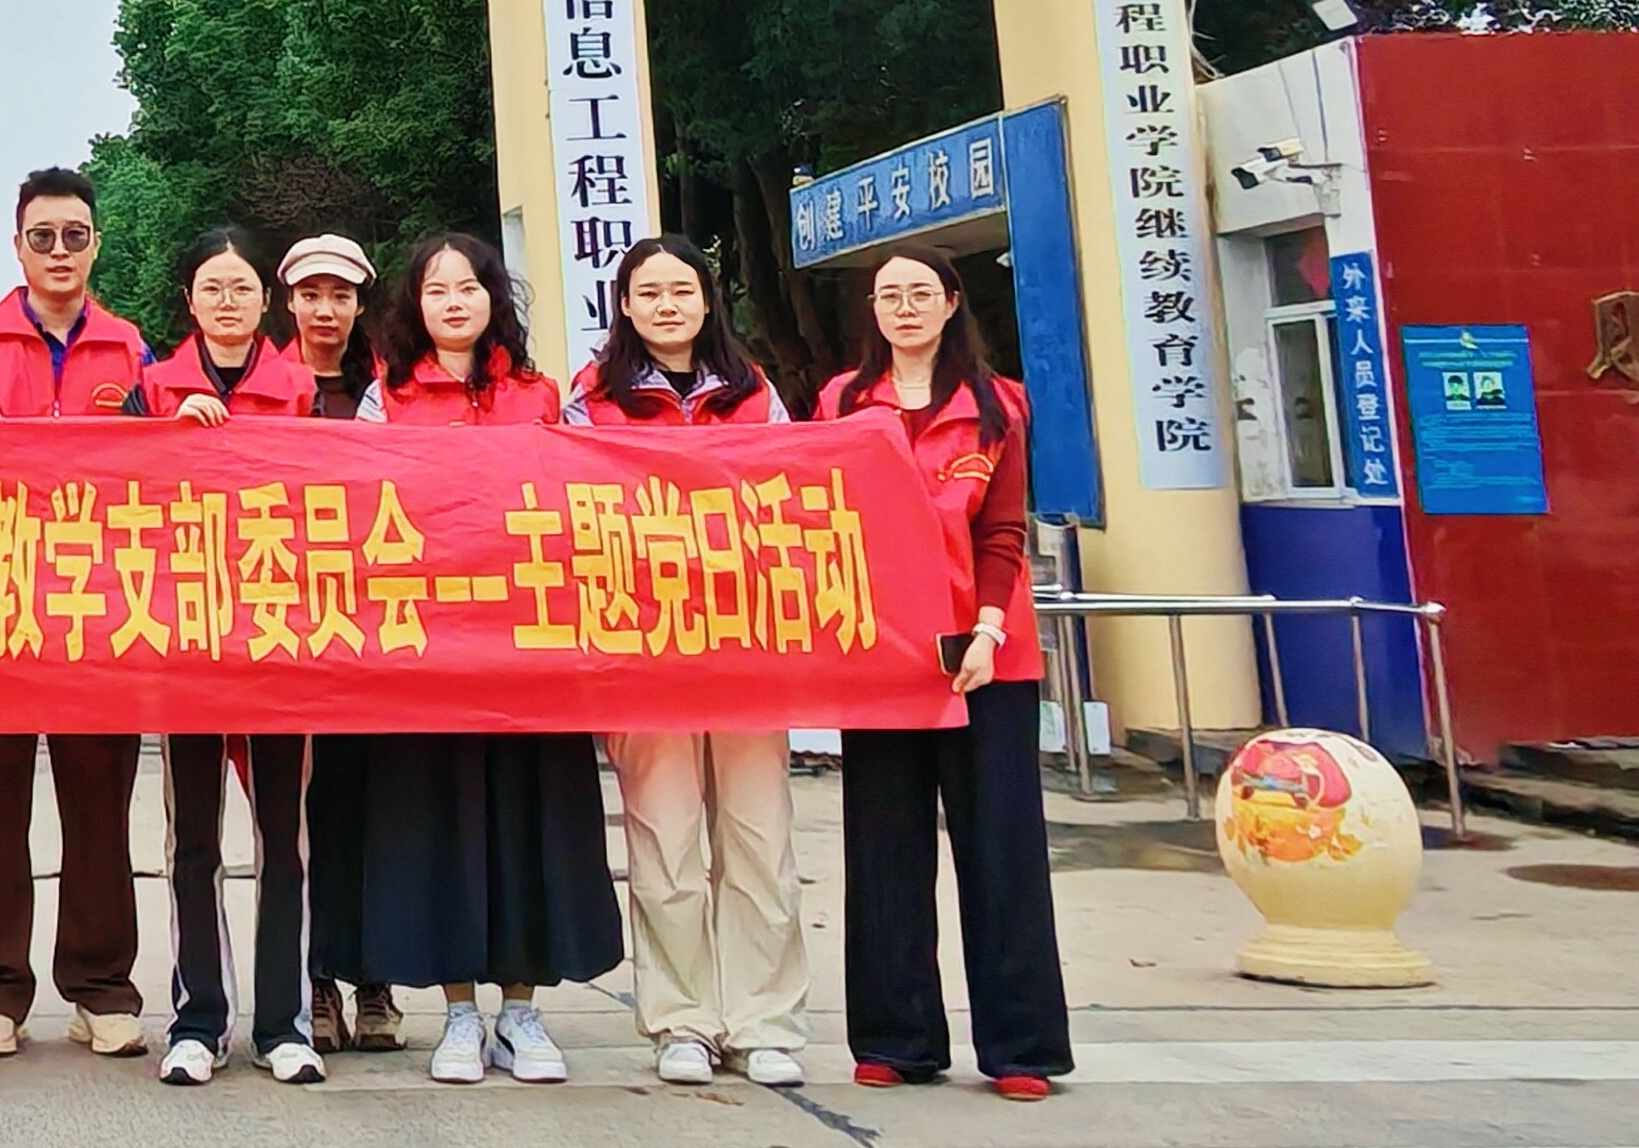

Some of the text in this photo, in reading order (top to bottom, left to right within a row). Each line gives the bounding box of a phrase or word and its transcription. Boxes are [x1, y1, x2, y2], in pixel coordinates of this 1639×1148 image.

[795, 137, 996, 251] 创建平安校园
[1341, 261, 1389, 486] 外来人员登记处
